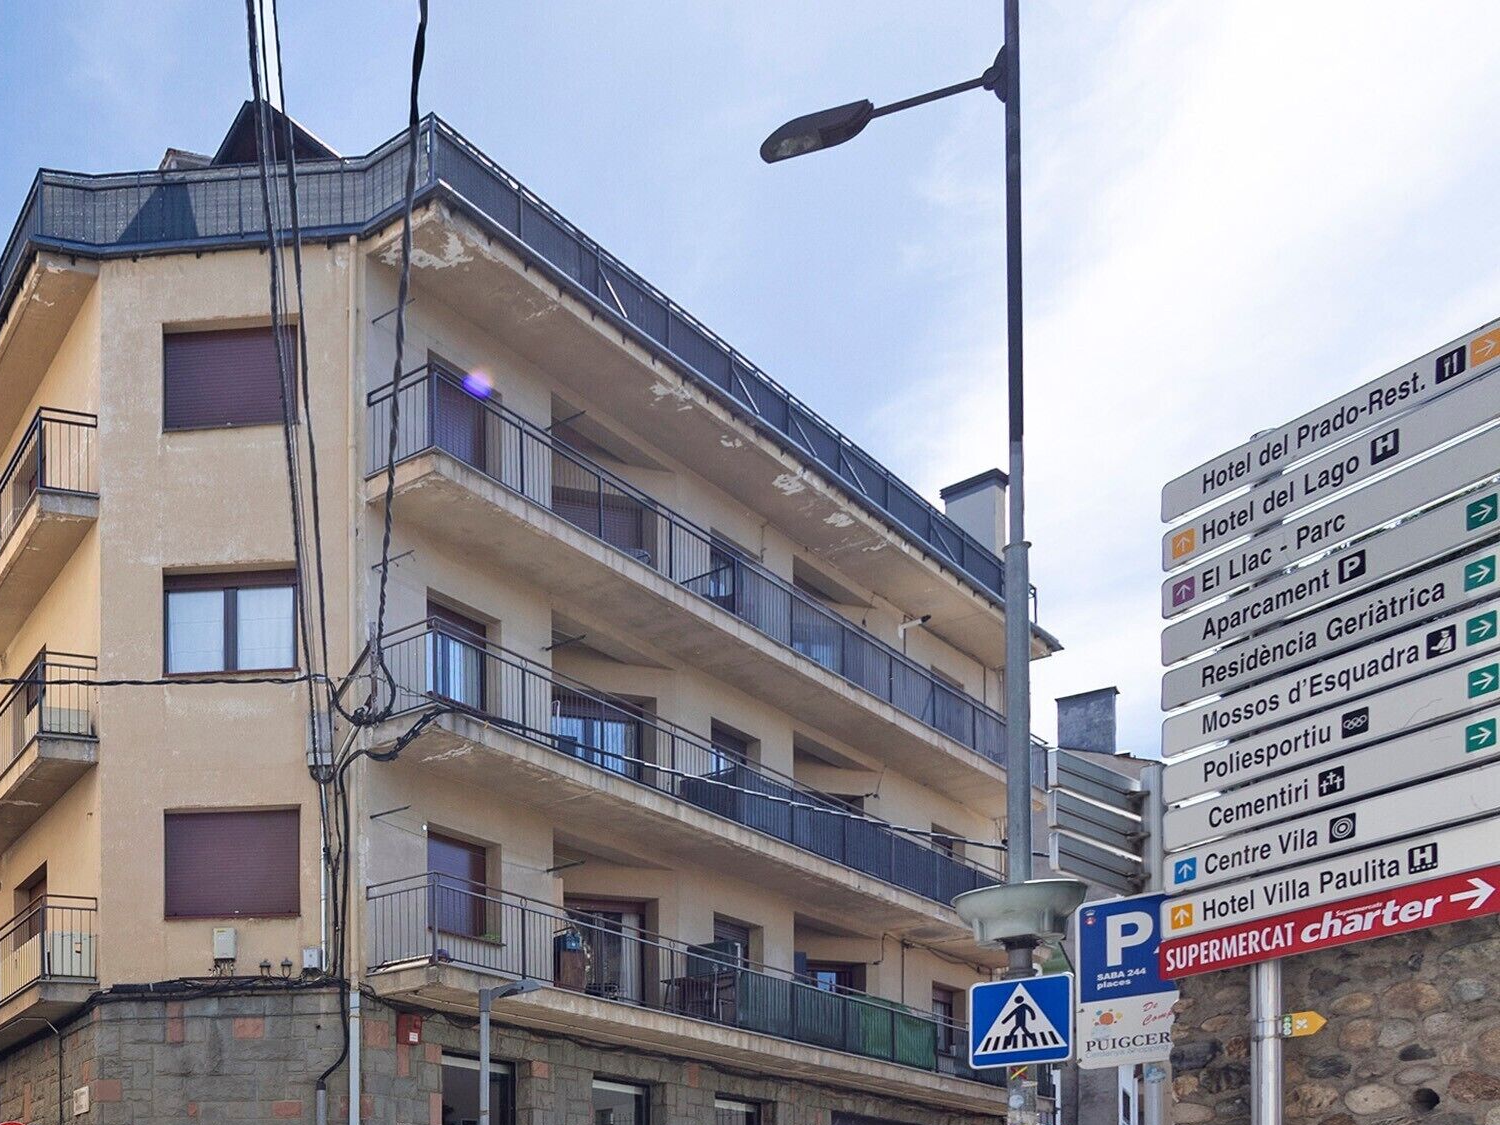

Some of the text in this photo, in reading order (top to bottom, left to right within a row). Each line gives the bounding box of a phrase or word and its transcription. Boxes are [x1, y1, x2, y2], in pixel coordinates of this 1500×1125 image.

[1202, 372, 1426, 494] Hotel del Prado-Rest.
[1202, 500, 1254, 544] Hotel
[1263, 482, 1294, 514] del
[1304, 455, 1360, 496] Lago
[1202, 565, 1220, 593] El
[1229, 545, 1272, 581] Llac
[1296, 514, 1346, 550] Parc
[1202, 569, 1330, 640] Aparcament
[1202, 581, 1446, 688] Residència Geriàtrica
[1202, 692, 1280, 735] Mossos
[1204, 725, 1331, 783] Poliesportiu
[1209, 778, 1309, 828] Cementiri
[1204, 828, 1318, 875] Centre Vila
[1203, 890, 1255, 922] Hotel
[1263, 876, 1310, 906] Villa
[1320, 858, 1400, 894] Paulita
[1106, 911, 1154, 968] P
[1165, 893, 1444, 973] SUPERMERCAT charter
[1096, 979, 1132, 990] places
[1097, 967, 1147, 982] SABA 244
